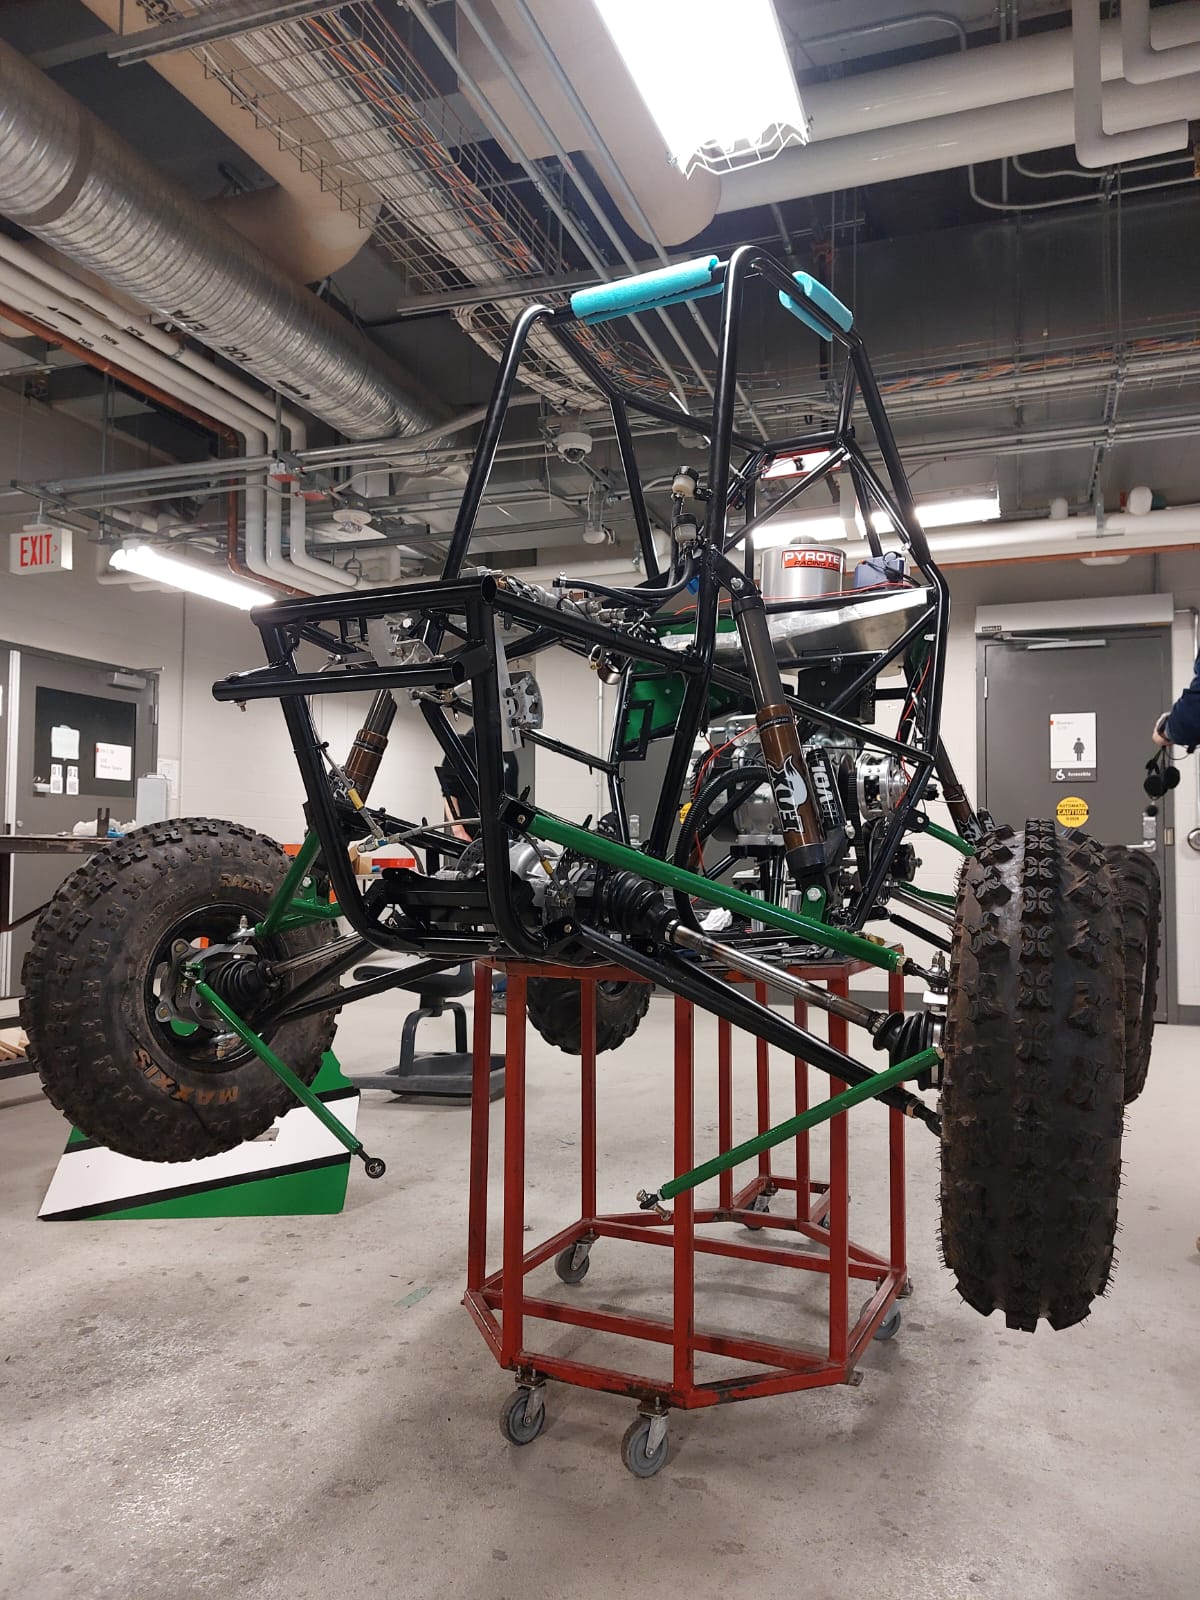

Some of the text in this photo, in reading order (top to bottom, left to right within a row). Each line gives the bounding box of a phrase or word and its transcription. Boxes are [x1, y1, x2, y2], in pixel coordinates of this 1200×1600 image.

[20, 534, 53, 567] EXIT
[784, 551, 840, 564] PYROTE
[767, 757, 806, 833] FOX
[133, 1047, 239, 1105] MAXXIS
